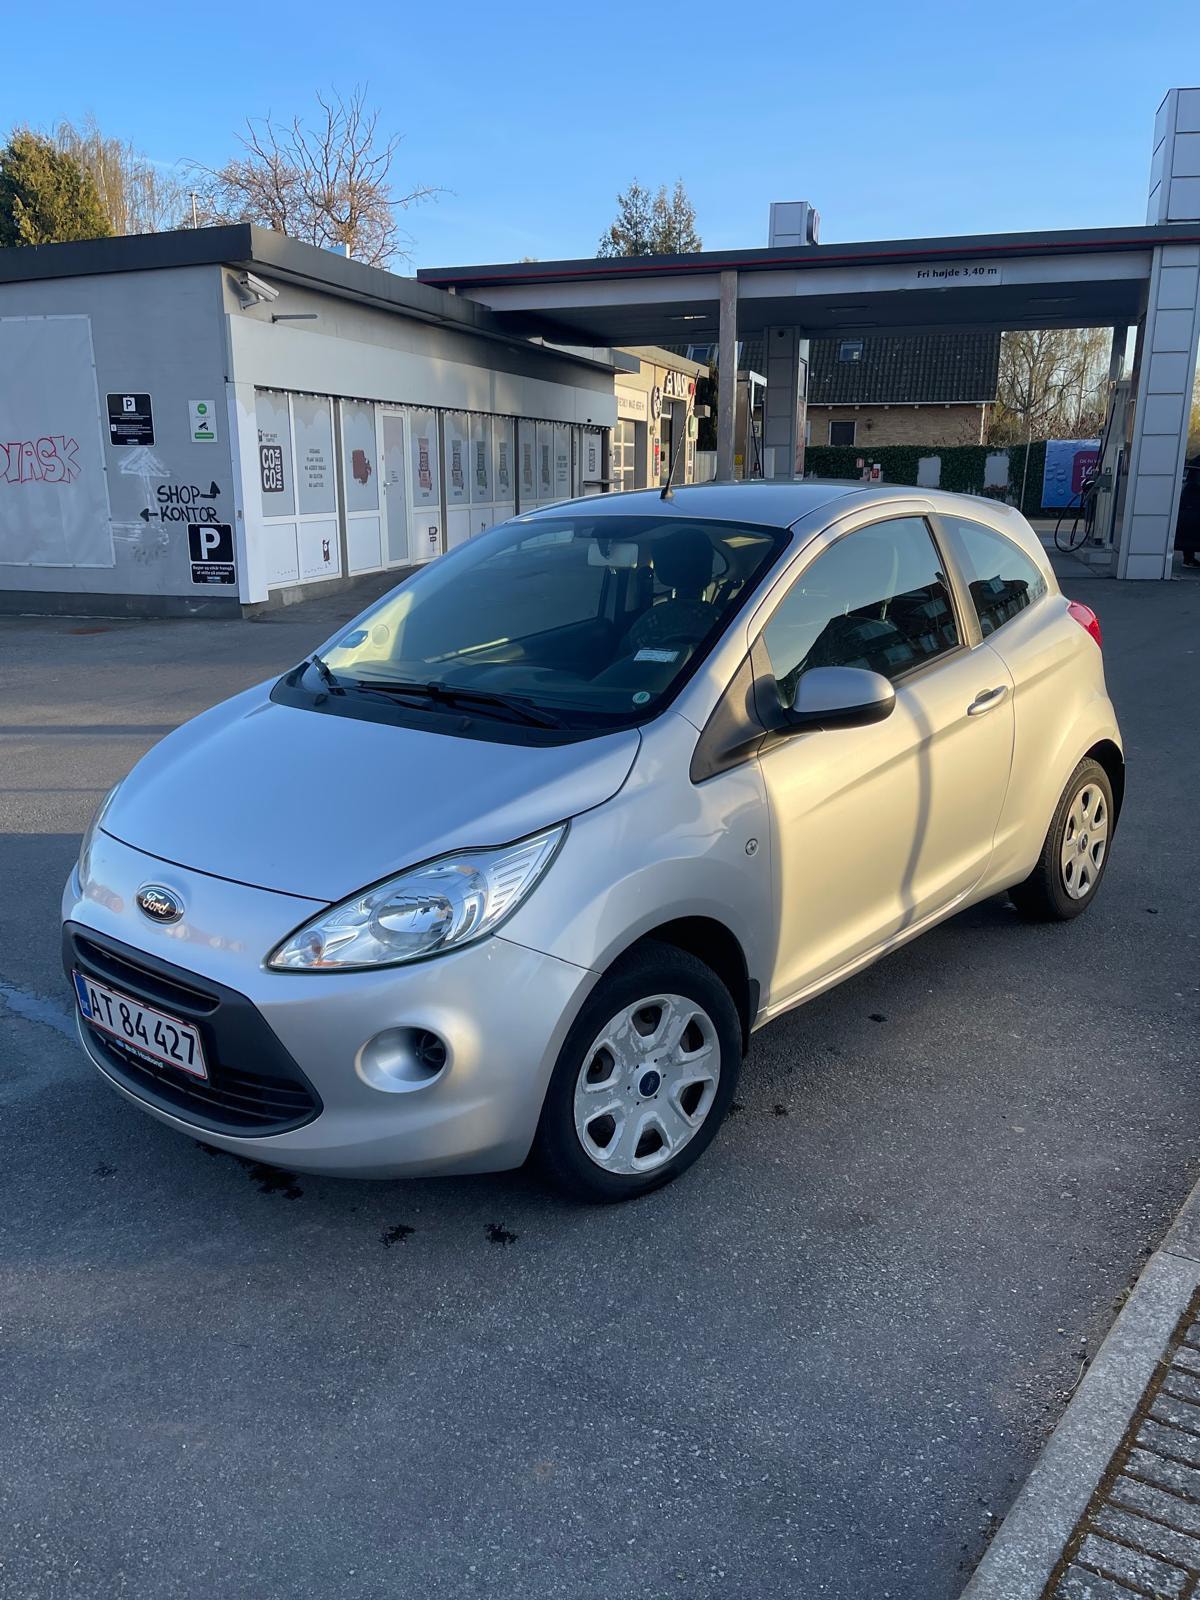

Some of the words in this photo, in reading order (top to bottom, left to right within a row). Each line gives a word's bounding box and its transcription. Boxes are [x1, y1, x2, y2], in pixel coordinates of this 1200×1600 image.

[917, 270, 929, 278] Fri
[932, 268, 960, 279] højde
[963, 267, 985, 277] 3,40
[274, 449, 283, 489] HAGEN
[157, 485, 200, 504] SHOP
[160, 505, 220, 523] KONTOR
[199, 527, 221, 560] P
[142, 891, 170, 915] Ford
[90, 987, 114, 1027] AT
[119, 1002, 149, 1046] 84
[154, 1020, 195, 1065] 427
